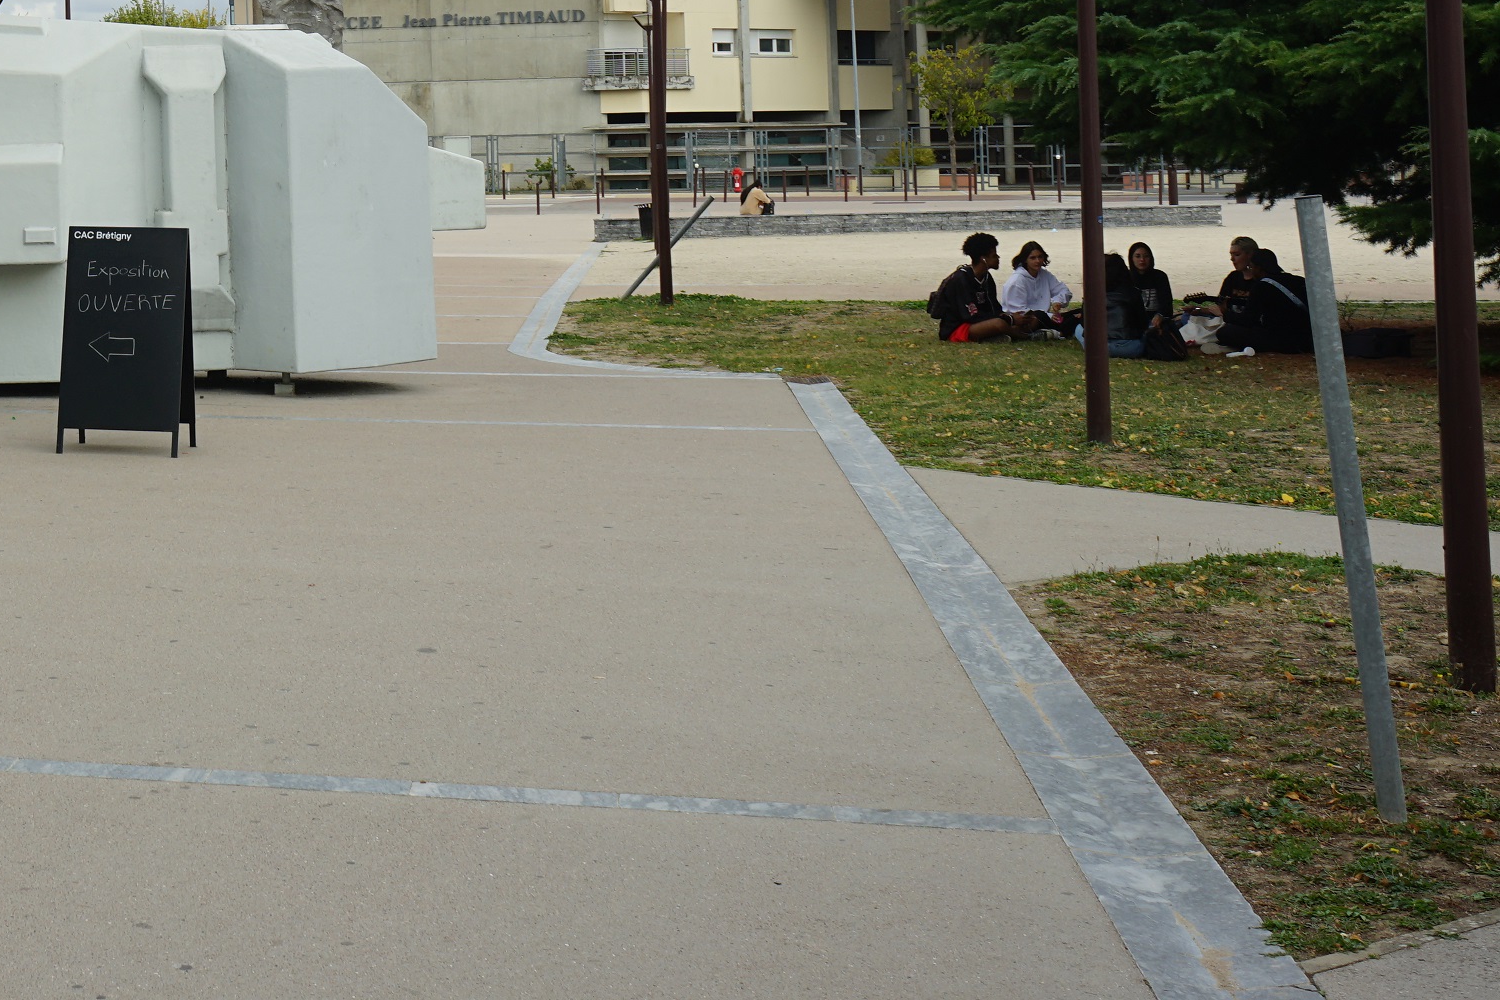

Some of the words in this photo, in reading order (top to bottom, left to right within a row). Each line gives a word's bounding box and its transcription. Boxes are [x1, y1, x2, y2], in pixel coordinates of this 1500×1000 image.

[343, 16, 382, 29] CEE
[402, 15, 437, 28] Jean
[443, 13, 491, 27] Pierre
[497, 9, 585, 25] TIMBAUD
[74, 231, 94, 239] CAC
[96, 231, 132, 242] Brétigny
[87, 260, 170, 285] Exposition
[78, 293, 176, 313] OUVERTE
